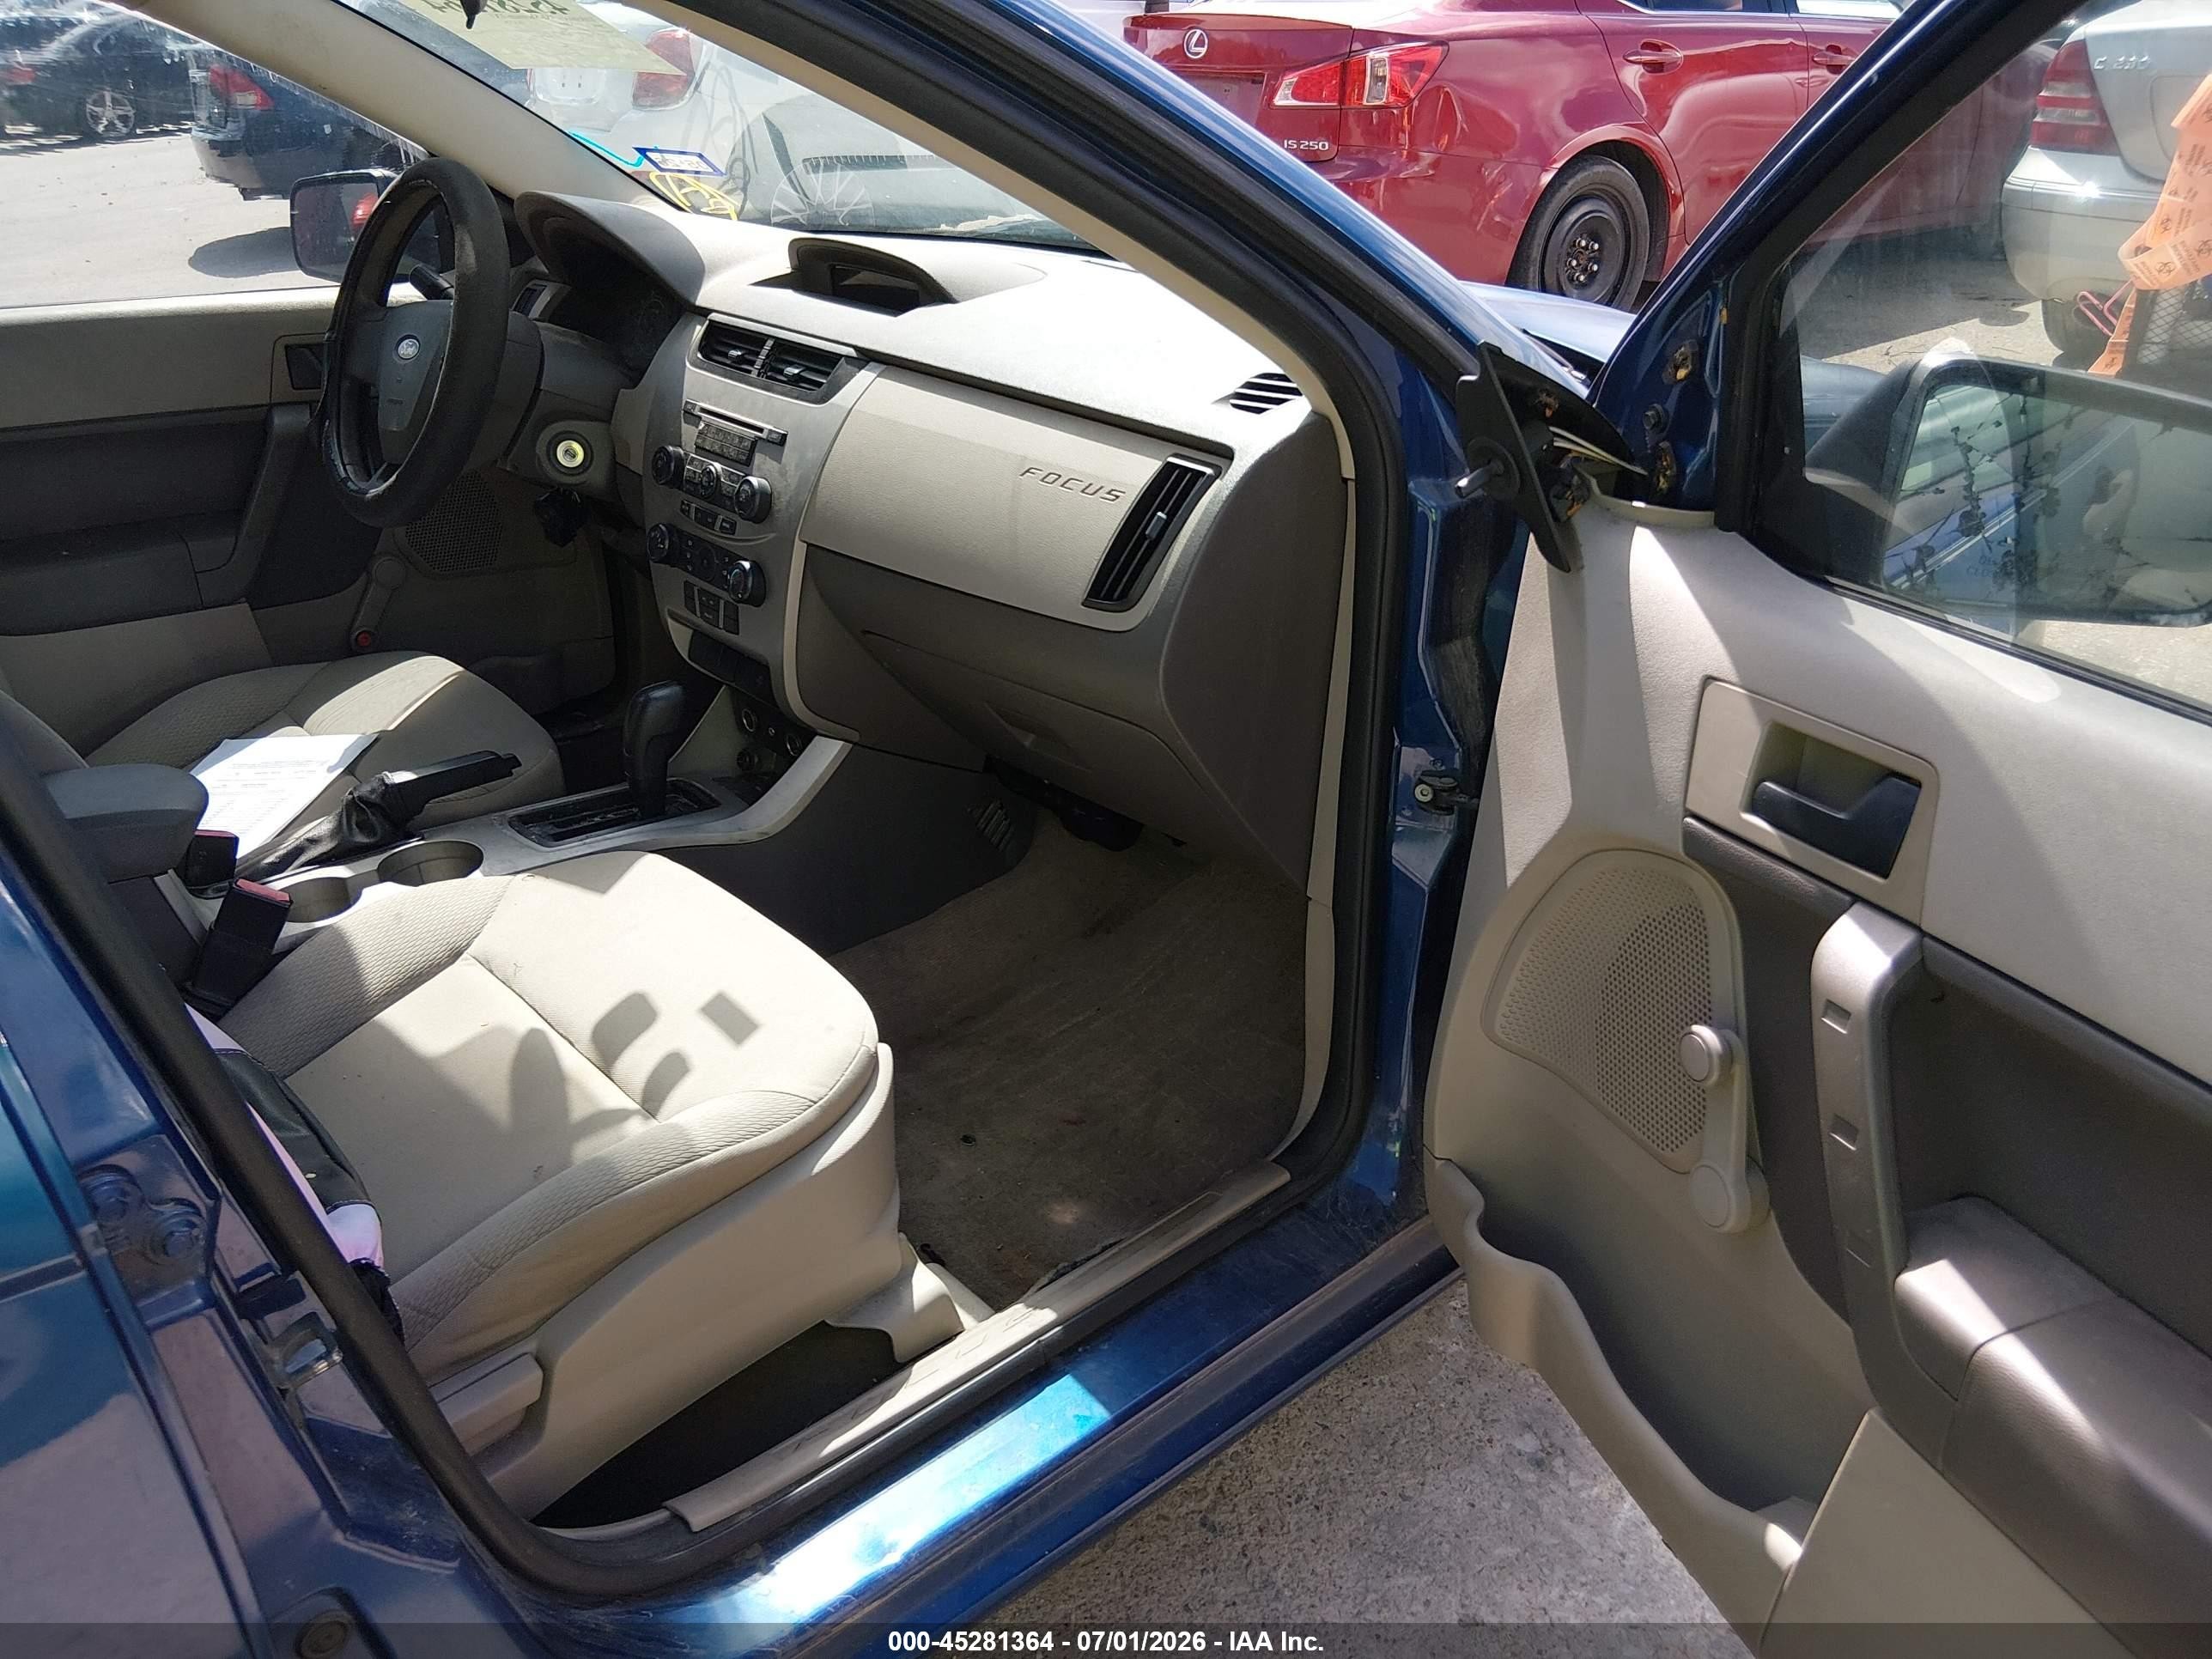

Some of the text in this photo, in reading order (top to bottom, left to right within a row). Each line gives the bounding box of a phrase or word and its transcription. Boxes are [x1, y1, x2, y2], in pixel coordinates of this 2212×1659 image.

[1284, 139, 1329, 151] IS 250
[1018, 466, 1127, 502] FOCUS
